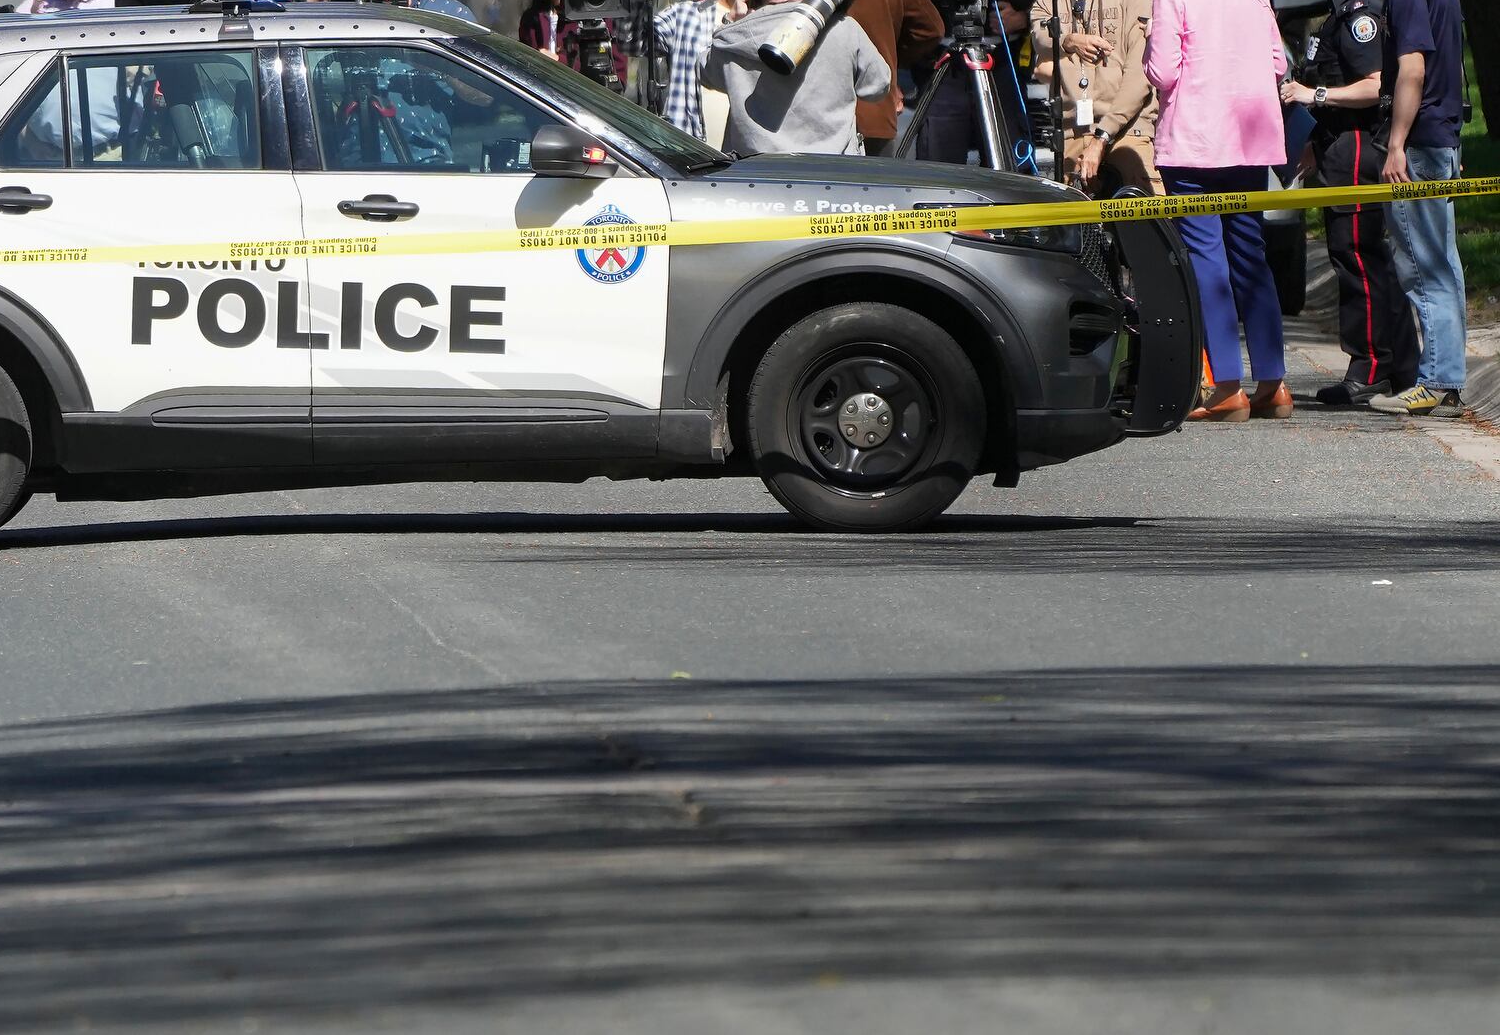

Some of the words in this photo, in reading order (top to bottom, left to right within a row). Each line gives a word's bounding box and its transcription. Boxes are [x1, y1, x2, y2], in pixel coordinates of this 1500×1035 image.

[692, 198, 717, 211] To
[722, 198, 786, 212] Serve
[793, 200, 809, 213] &
[816, 200, 897, 214] Protect
[1100, 201, 1123, 209] (TIPS)
[1125, 198, 1186, 208] 1-800-222-8477
[1210, 202, 1247, 211] POLICE
[1139, 208, 1159, 216] NOT
[1164, 206, 1177, 214] DO
[1182, 205, 1205, 213] LINE
[836, 214, 895, 223] 1-800-222-8477
[898, 211, 932, 219] Stoppers
[1100, 210, 1134, 219] CROSS
[591, 215, 630, 226] TORONTO
[810, 216, 832, 225] (TIPS)
[920, 219, 957, 229] POLICE
[608, 225, 642, 233] Stoppers
[645, 224, 667, 232] Crime
[810, 225, 843, 234] CROSS
[849, 223, 868, 232] NOT
[874, 222, 886, 231] DO
[892, 221, 915, 230] LINE
[545, 228, 605, 236] 1-800-222-8477
[559, 236, 578, 245] NOT
[584, 236, 596, 244] DO
[602, 234, 625, 243] LINE
[630, 233, 666, 242] POLICE
[520, 238, 553, 247] CROSS
[230, 248, 264, 256] CROSS
[269, 247, 288, 255] NOT
[294, 246, 307, 254] DO
[312, 245, 335, 253] LINE
[340, 244, 376, 252] POLICE
[22, 254, 44, 262] LINE
[49, 253, 87, 261] POLICE
[596, 272, 627, 282] POLICE
[131, 277, 507, 355] POLICE
